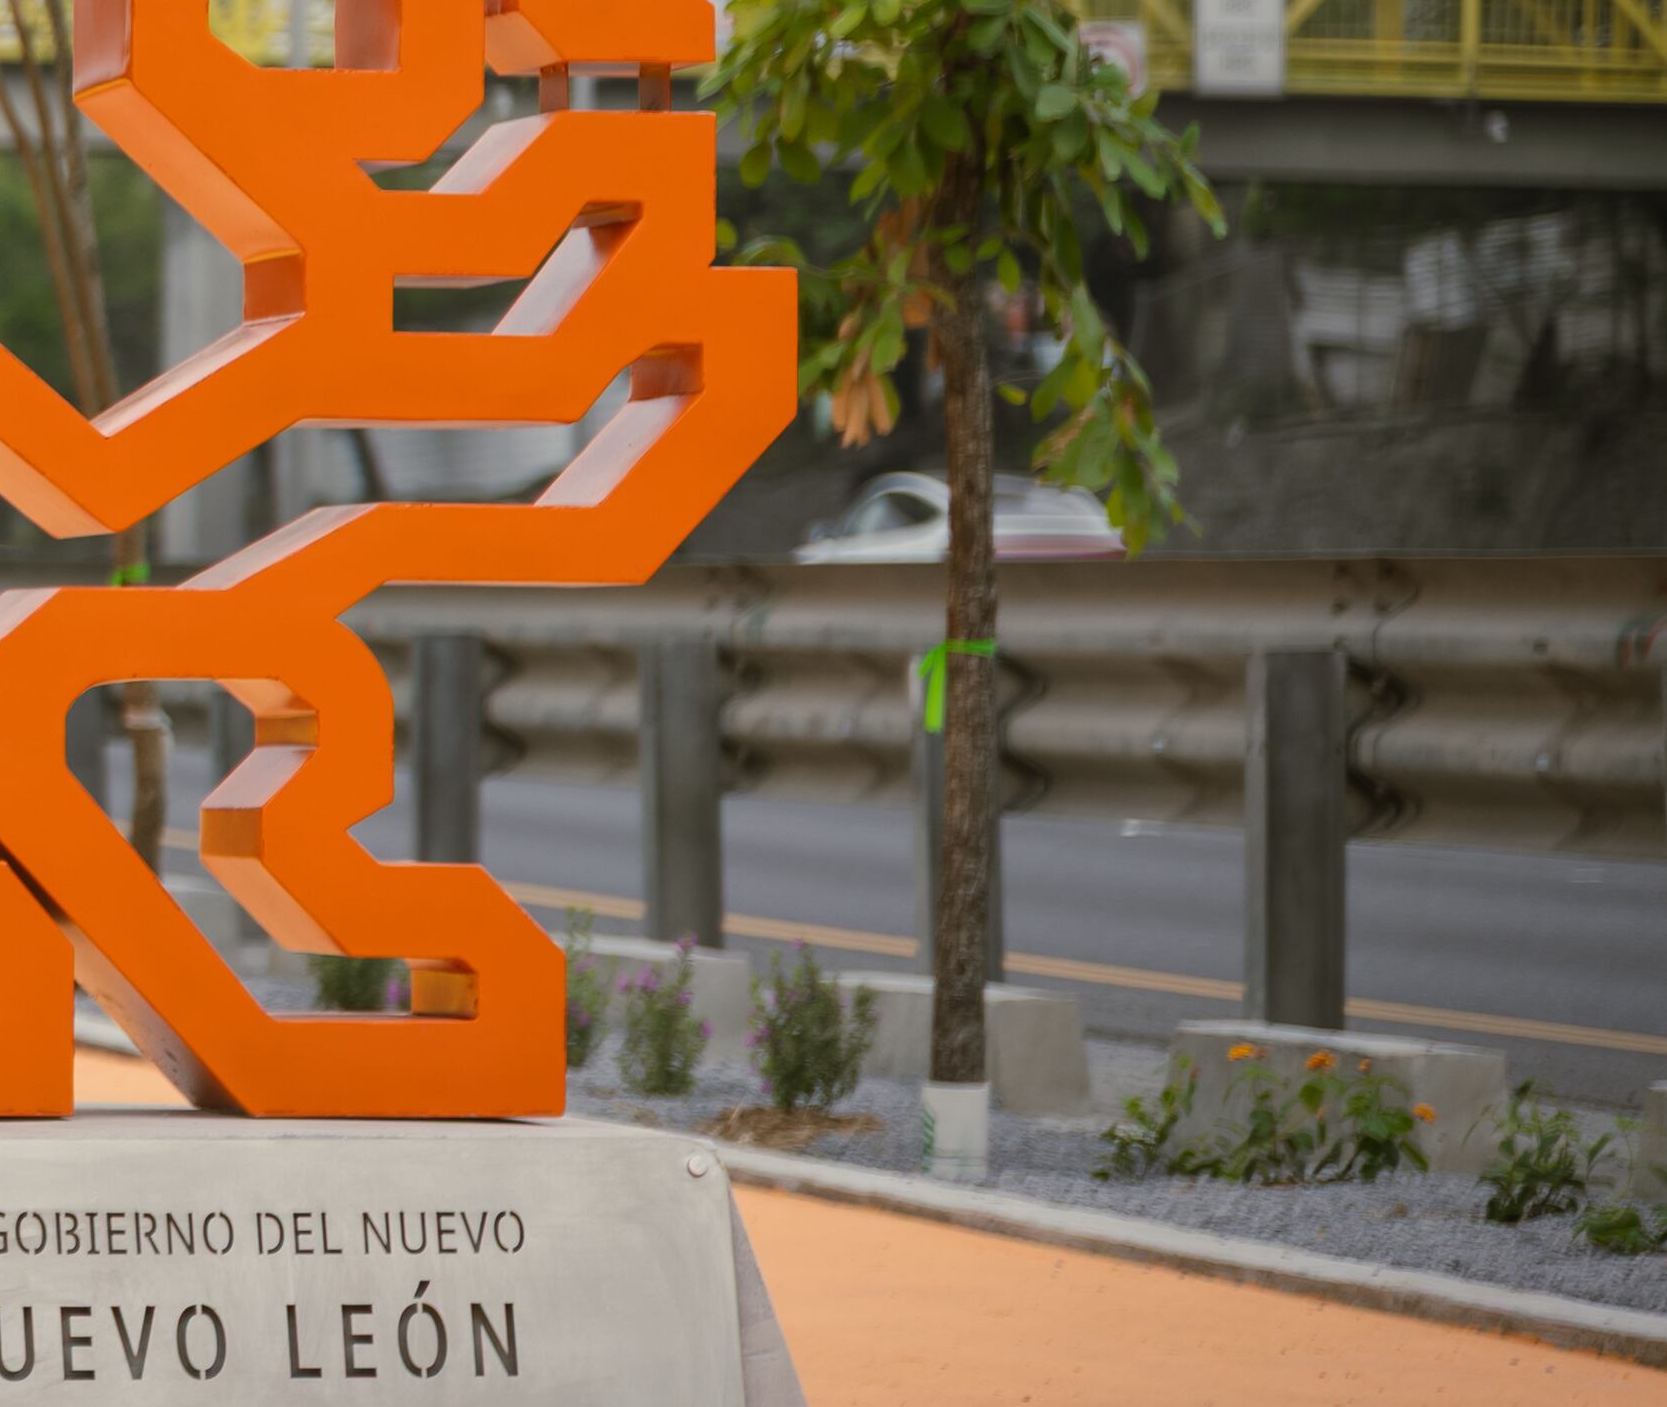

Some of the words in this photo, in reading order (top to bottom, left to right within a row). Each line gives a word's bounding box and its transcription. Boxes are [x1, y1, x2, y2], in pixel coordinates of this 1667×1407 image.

[255, 1211, 343, 1255] DEL
[362, 1210, 525, 1255] NUEVO
[285, 1279, 519, 1380] LEÓN
